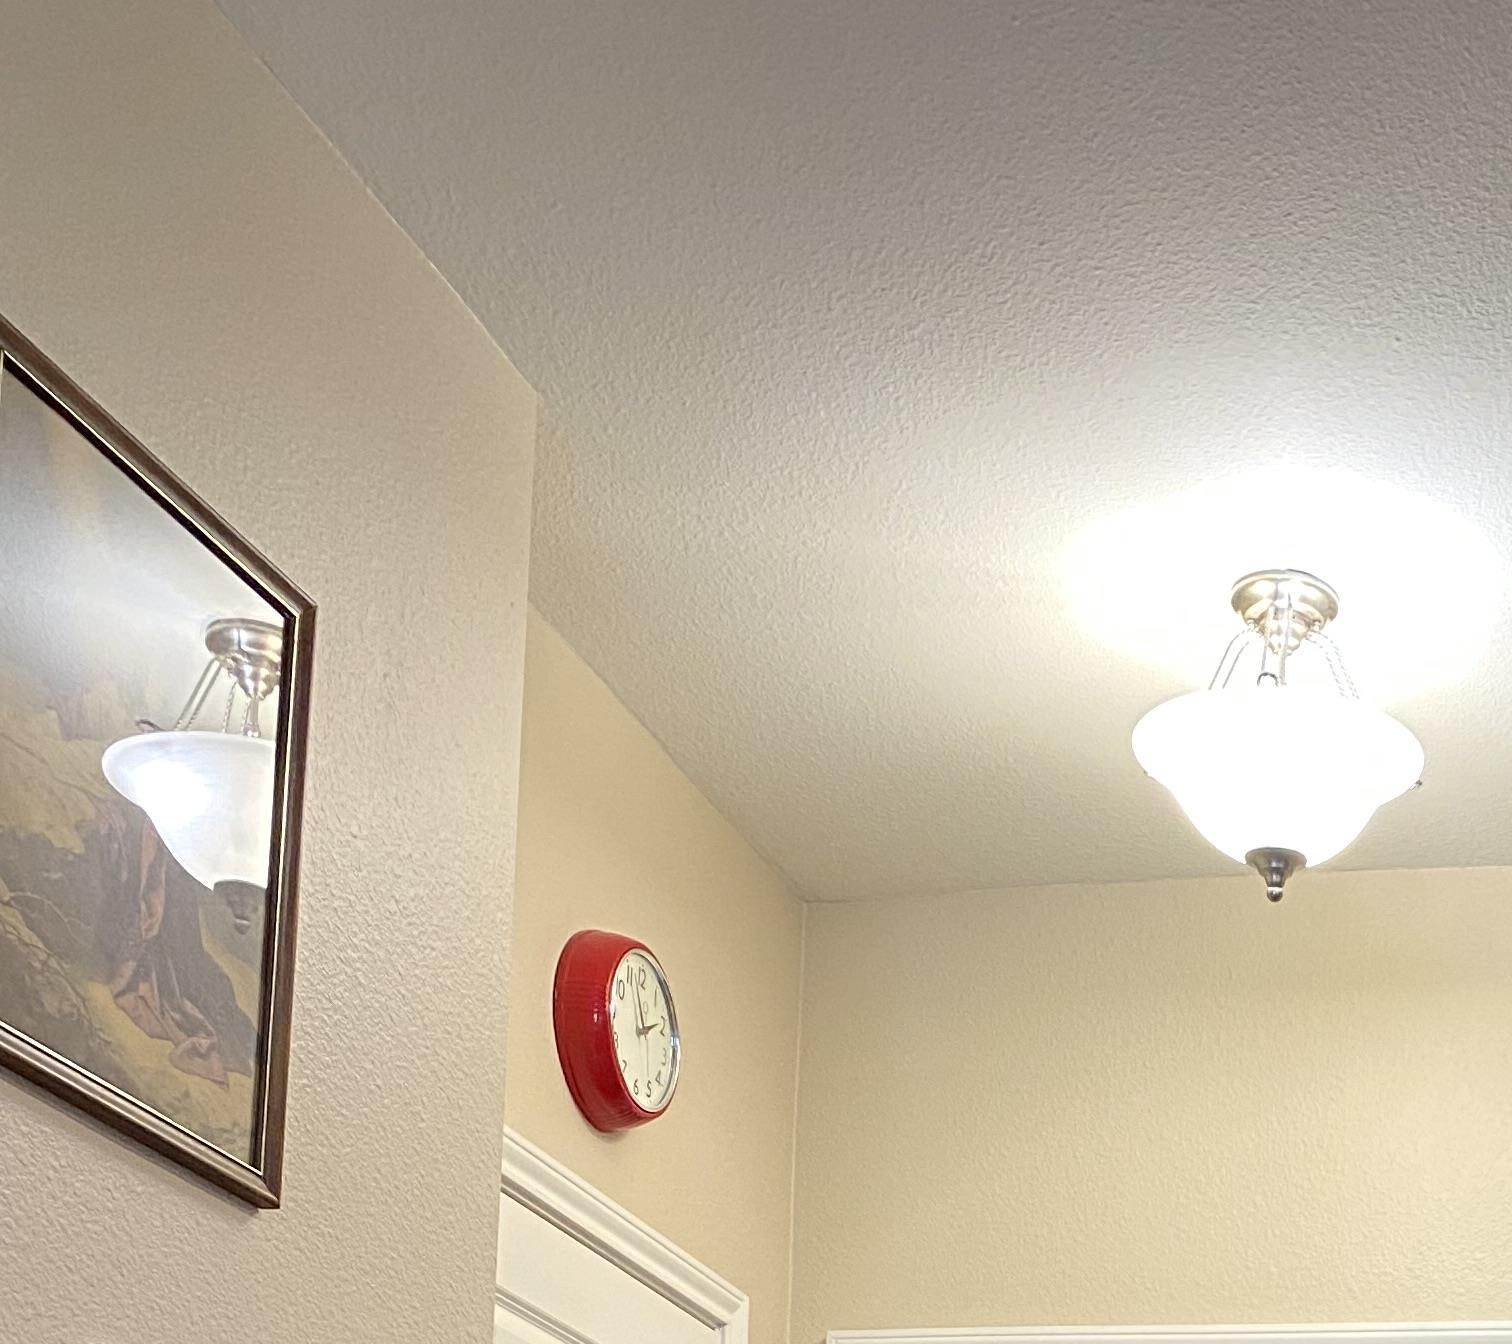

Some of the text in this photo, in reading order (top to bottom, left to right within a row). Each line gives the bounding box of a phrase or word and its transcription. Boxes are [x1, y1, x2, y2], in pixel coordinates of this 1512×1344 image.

[638, 966, 646, 990] 12
[616, 976, 625, 1000] 10
[660, 1015, 666, 1036] 2
[661, 1047, 667, 1066] 3
[633, 1078, 639, 1095] 6
[655, 1070, 664, 1087] 4
[646, 1080, 652, 1098] 5
